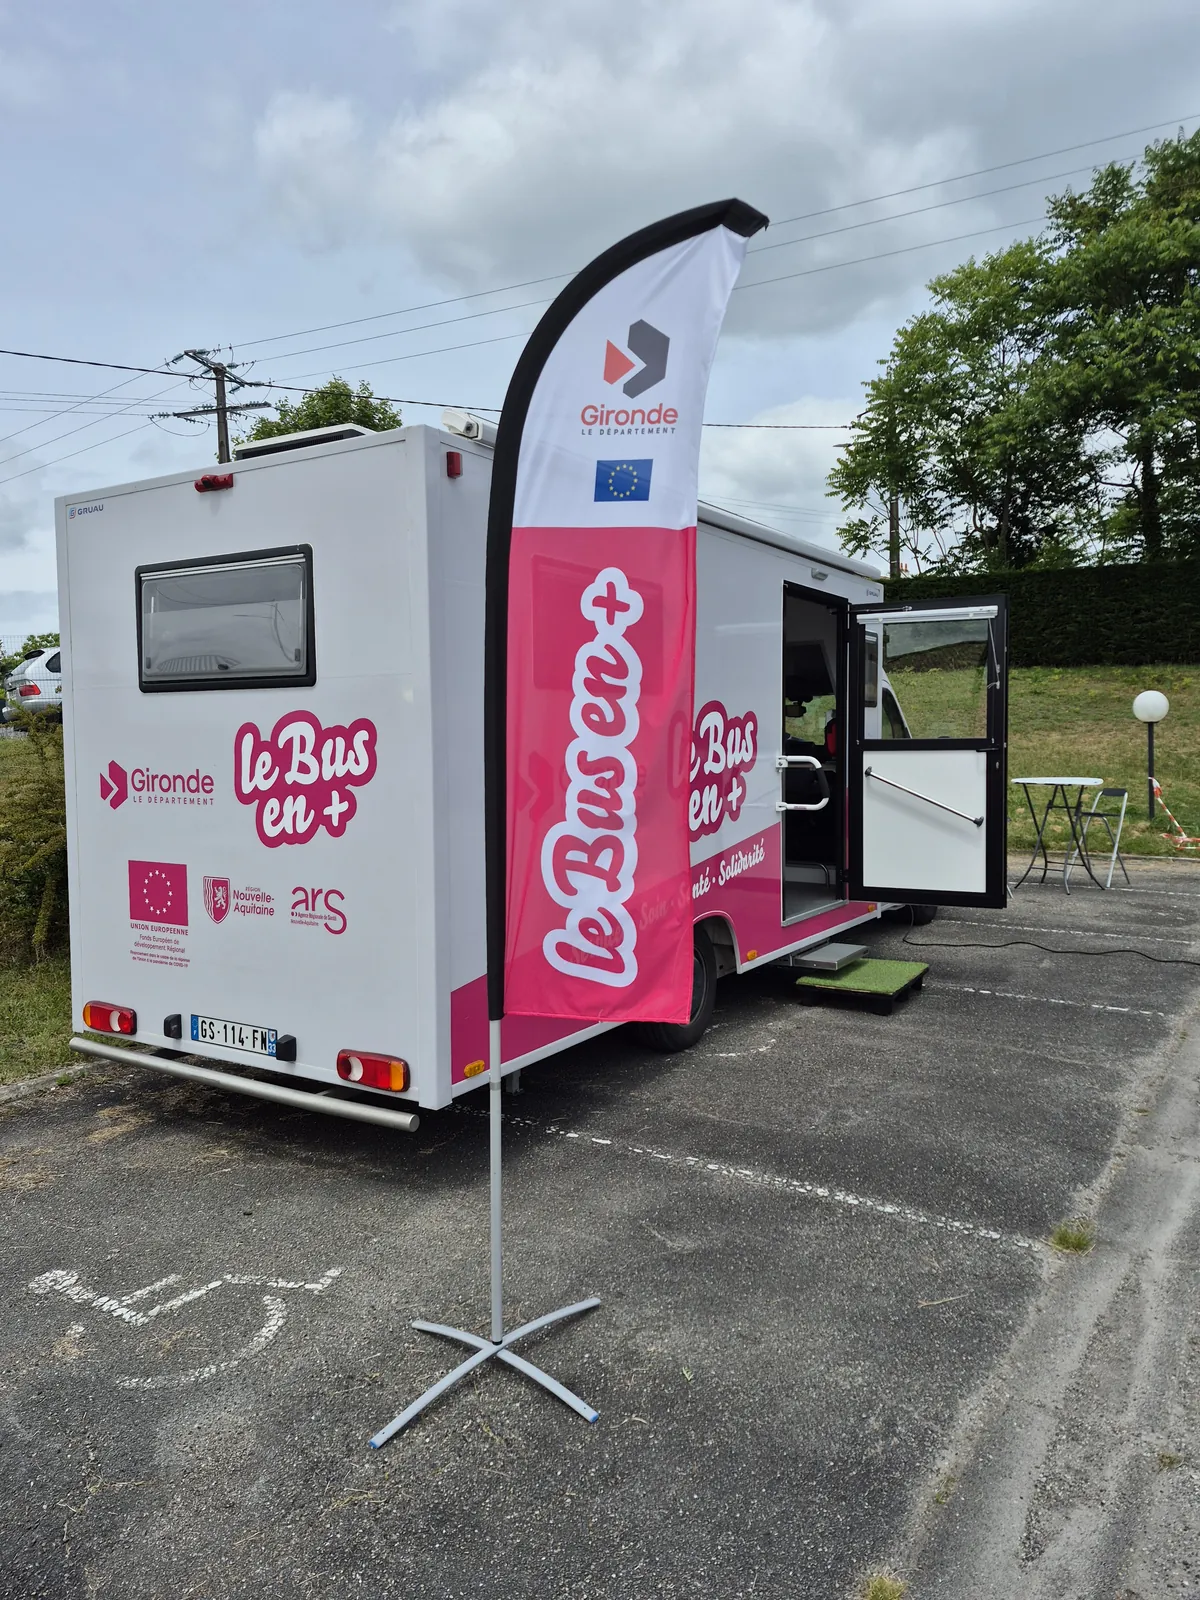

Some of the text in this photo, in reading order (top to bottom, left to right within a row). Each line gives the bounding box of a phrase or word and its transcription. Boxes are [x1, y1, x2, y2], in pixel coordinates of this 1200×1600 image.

[581, 403, 678, 426] Gironde
[599, 427, 676, 436] DÉPARTEMENT
[77, 504, 104, 516] GRUAU
[580, 642, 630, 737] en
[700, 711, 754, 776] Bus
[241, 721, 369, 794] le Bus
[131, 767, 214, 794] Gironde
[147, 795, 214, 805] DÉPARTEMENT
[688, 783, 723, 832] en
[262, 794, 315, 837] en
[552, 750, 625, 897] Bus
[718, 838, 766, 886] Solidarité
[233, 889, 275, 903] Nouvelle-
[233, 902, 275, 916] Aquitaine
[130, 923, 189, 936] UNION EUROPEENNE
[554, 906, 625, 975] le
[268, 1042, 276, 1053] 33
